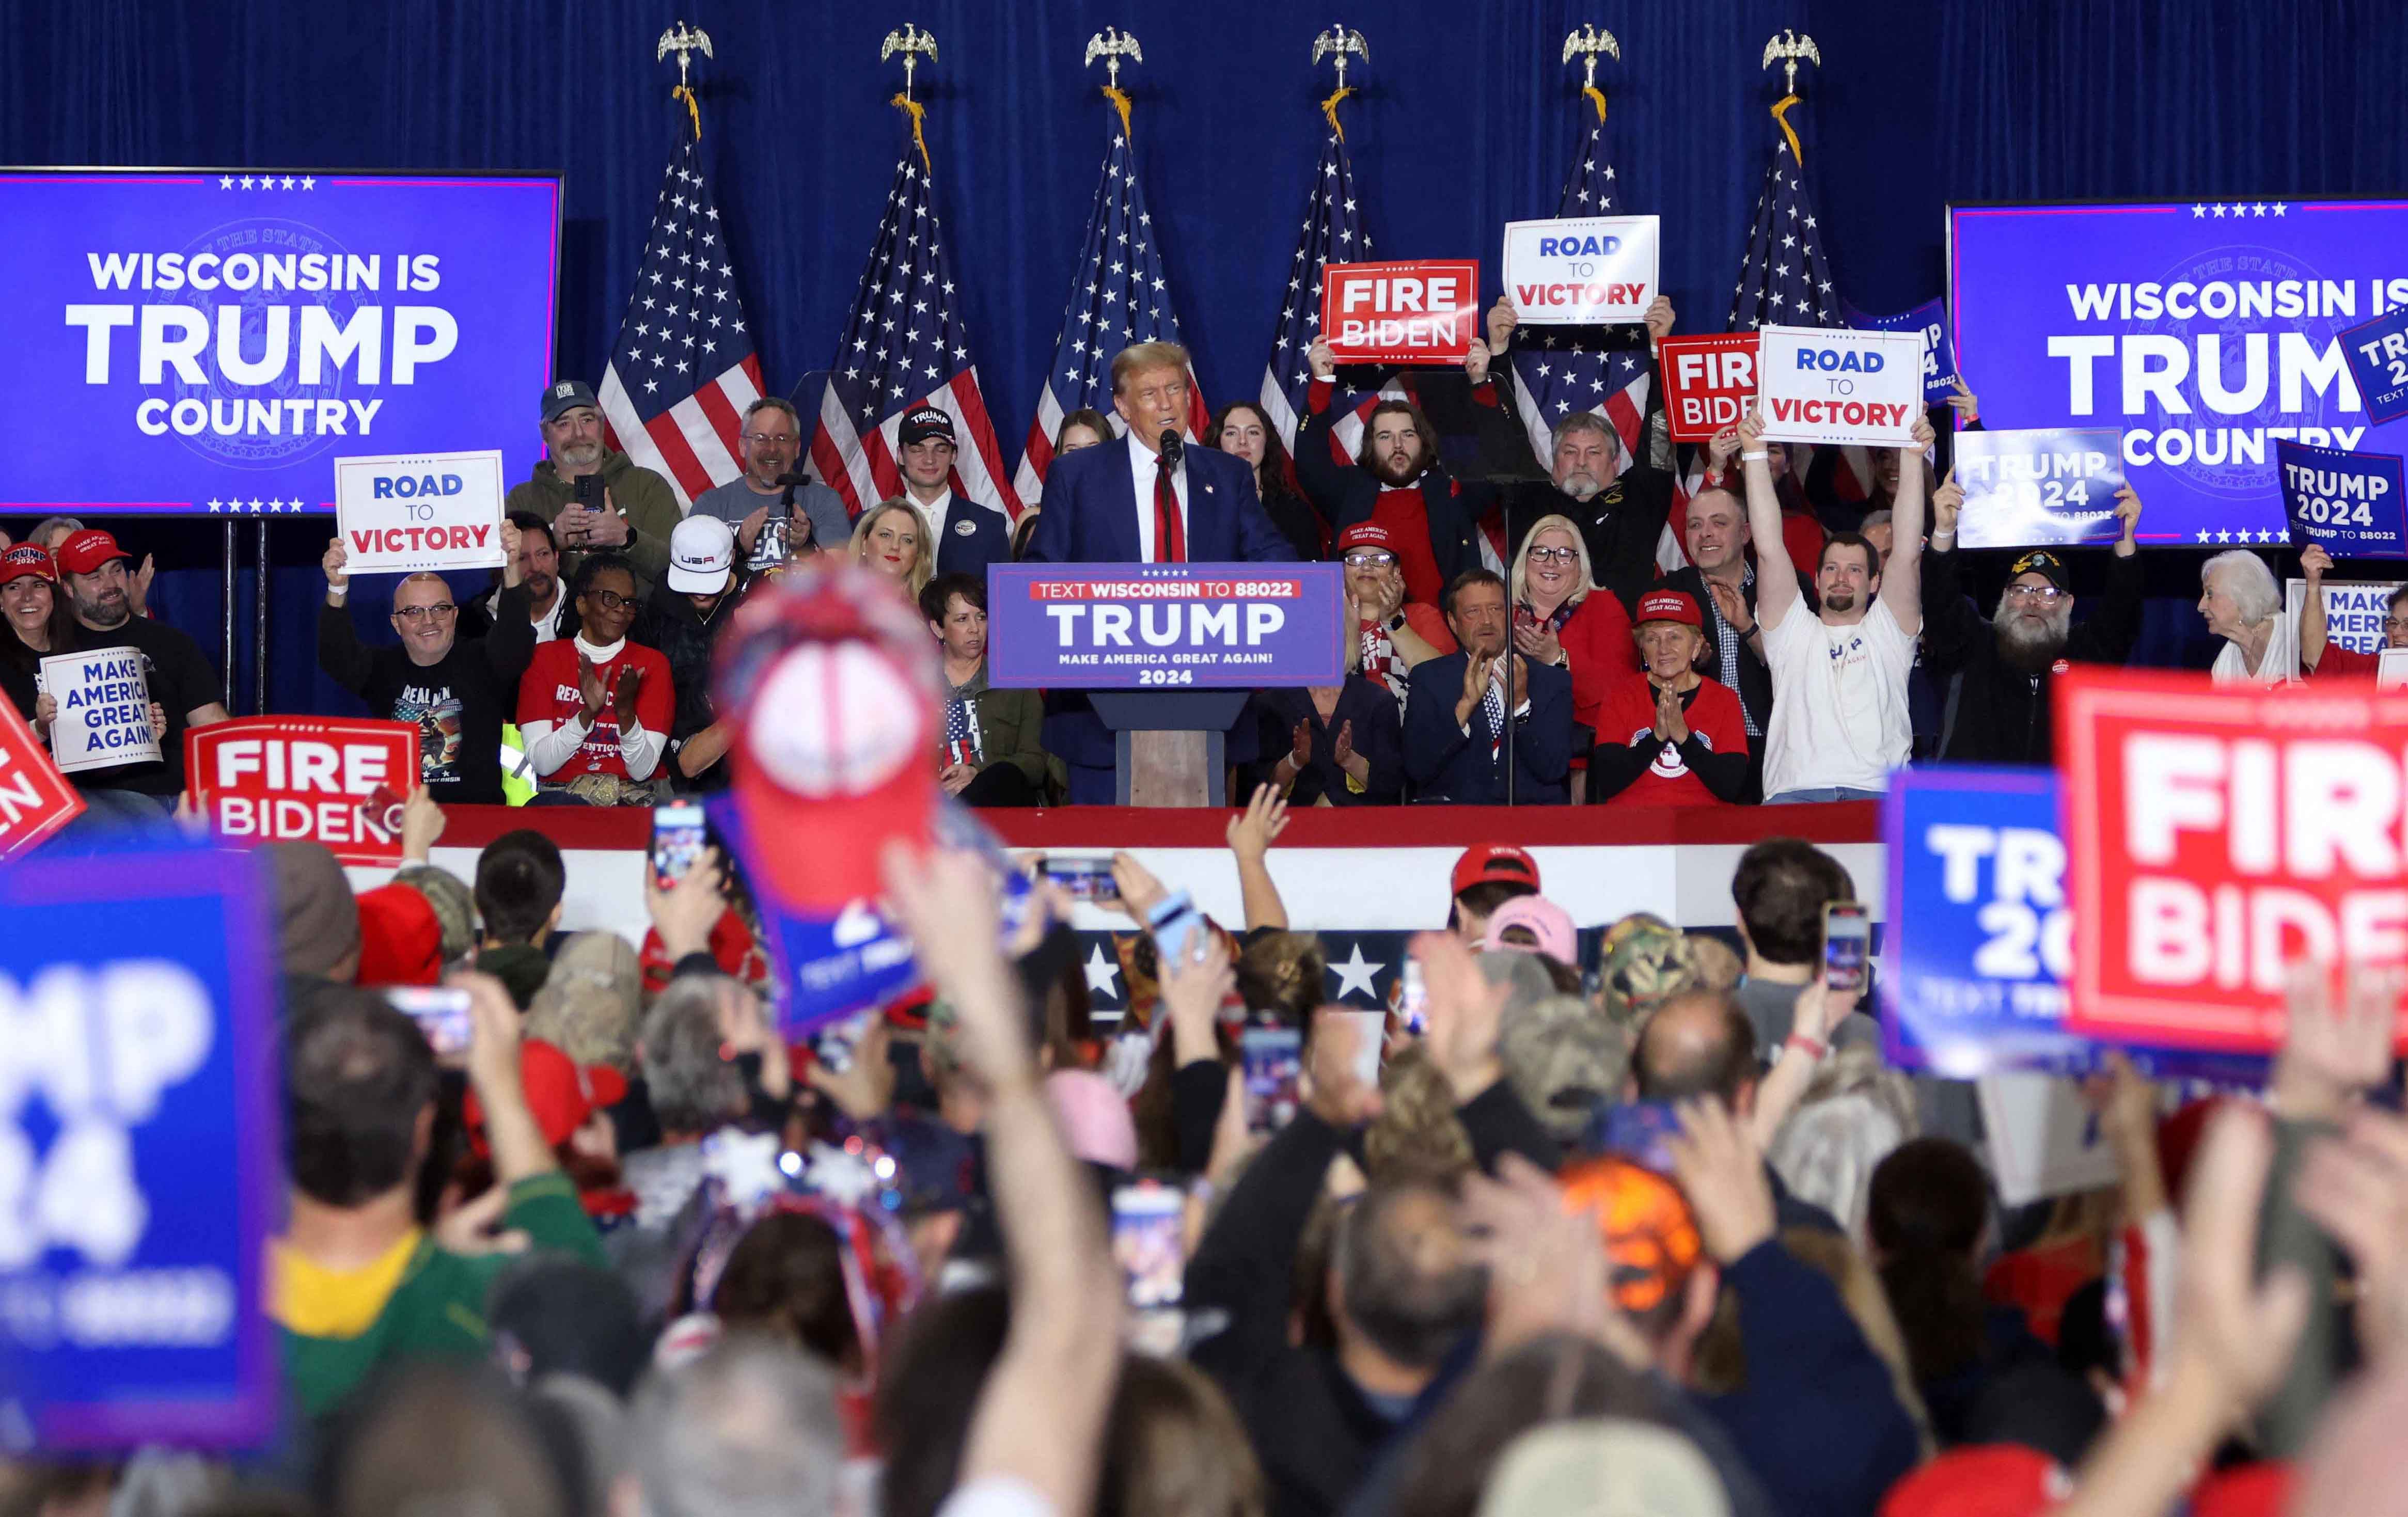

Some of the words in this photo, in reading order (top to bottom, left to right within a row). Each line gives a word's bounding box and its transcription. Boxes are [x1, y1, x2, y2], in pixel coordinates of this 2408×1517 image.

[1539, 235, 1622, 257] ROAD
[87, 252, 381, 291] WISCONSIN
[397, 254, 440, 292] IS
[1568, 262, 1594, 278] TO
[1343, 277, 1457, 312] FIRE
[1516, 283, 1646, 306] VICTORY
[2066, 279, 2356, 321] WISCONSIN
[65, 304, 459, 386] TRUMP
[1342, 321, 1457, 347] BIDEN
[1677, 352, 1756, 390] FIR
[1797, 348, 1884, 373] ROAD
[1827, 378, 1854, 395] TO
[1927, 374, 1956, 389] 88022
[2048, 333, 2361, 415] TRUM
[2376, 388, 2404, 405] TEXT
[136, 398, 383, 437] COUNTRY
[911, 411, 948, 423] TRUMP
[1682, 394, 1758, 425] BIDE
[1771, 398, 1909, 426] VICTORY
[1969, 451, 2107, 480] TRUMP
[374, 474, 463, 499] ROAD
[1994, 480, 2089, 507] 2024
[2286, 463, 2389, 500] TRUMP
[405, 504, 433, 520] TO
[2074, 510, 2114, 521] 88022
[2297, 494, 2373, 526] 2024
[351, 524, 491, 553] VICTORY
[1364, 527, 1388, 535] AMERICA
[2305, 526, 2337, 538] TRUMP
[2340, 531, 2356, 540] TO
[5, 547, 46, 563] TRUMP
[75, 539, 91, 550] MAKE
[681, 555, 714, 564] USA
[1039, 583, 1085, 598] TEXT
[1091, 582, 1200, 597] WISCONSIN
[1205, 582, 1230, 597] TO
[1235, 582, 1293, 597] 88022
[2331, 592, 2386, 611] MAK
[1046, 603, 1285, 646] TRUMP
[2327, 614, 2388, 632] MERI
[83, 659, 137, 683] MAKE
[1059, 654, 1098, 665] MAKE
[1103, 654, 1167, 665] AMERICA
[1172, 653, 1218, 663] GREAT
[1223, 653, 1273, 663] AGAIN!
[1139, 670, 1192, 684] 2024
[66, 681, 147, 709] AMERICA
[402, 684, 430, 704] REAL
[85, 703, 147, 728] GREAT
[86, 725, 153, 752] AGAIN!
[583, 742, 621, 752] ENTION
[217, 740, 388, 797] FIRE
[2121, 731, 2408, 879] FIR
[2128, 874, 2408, 994] BIDE
